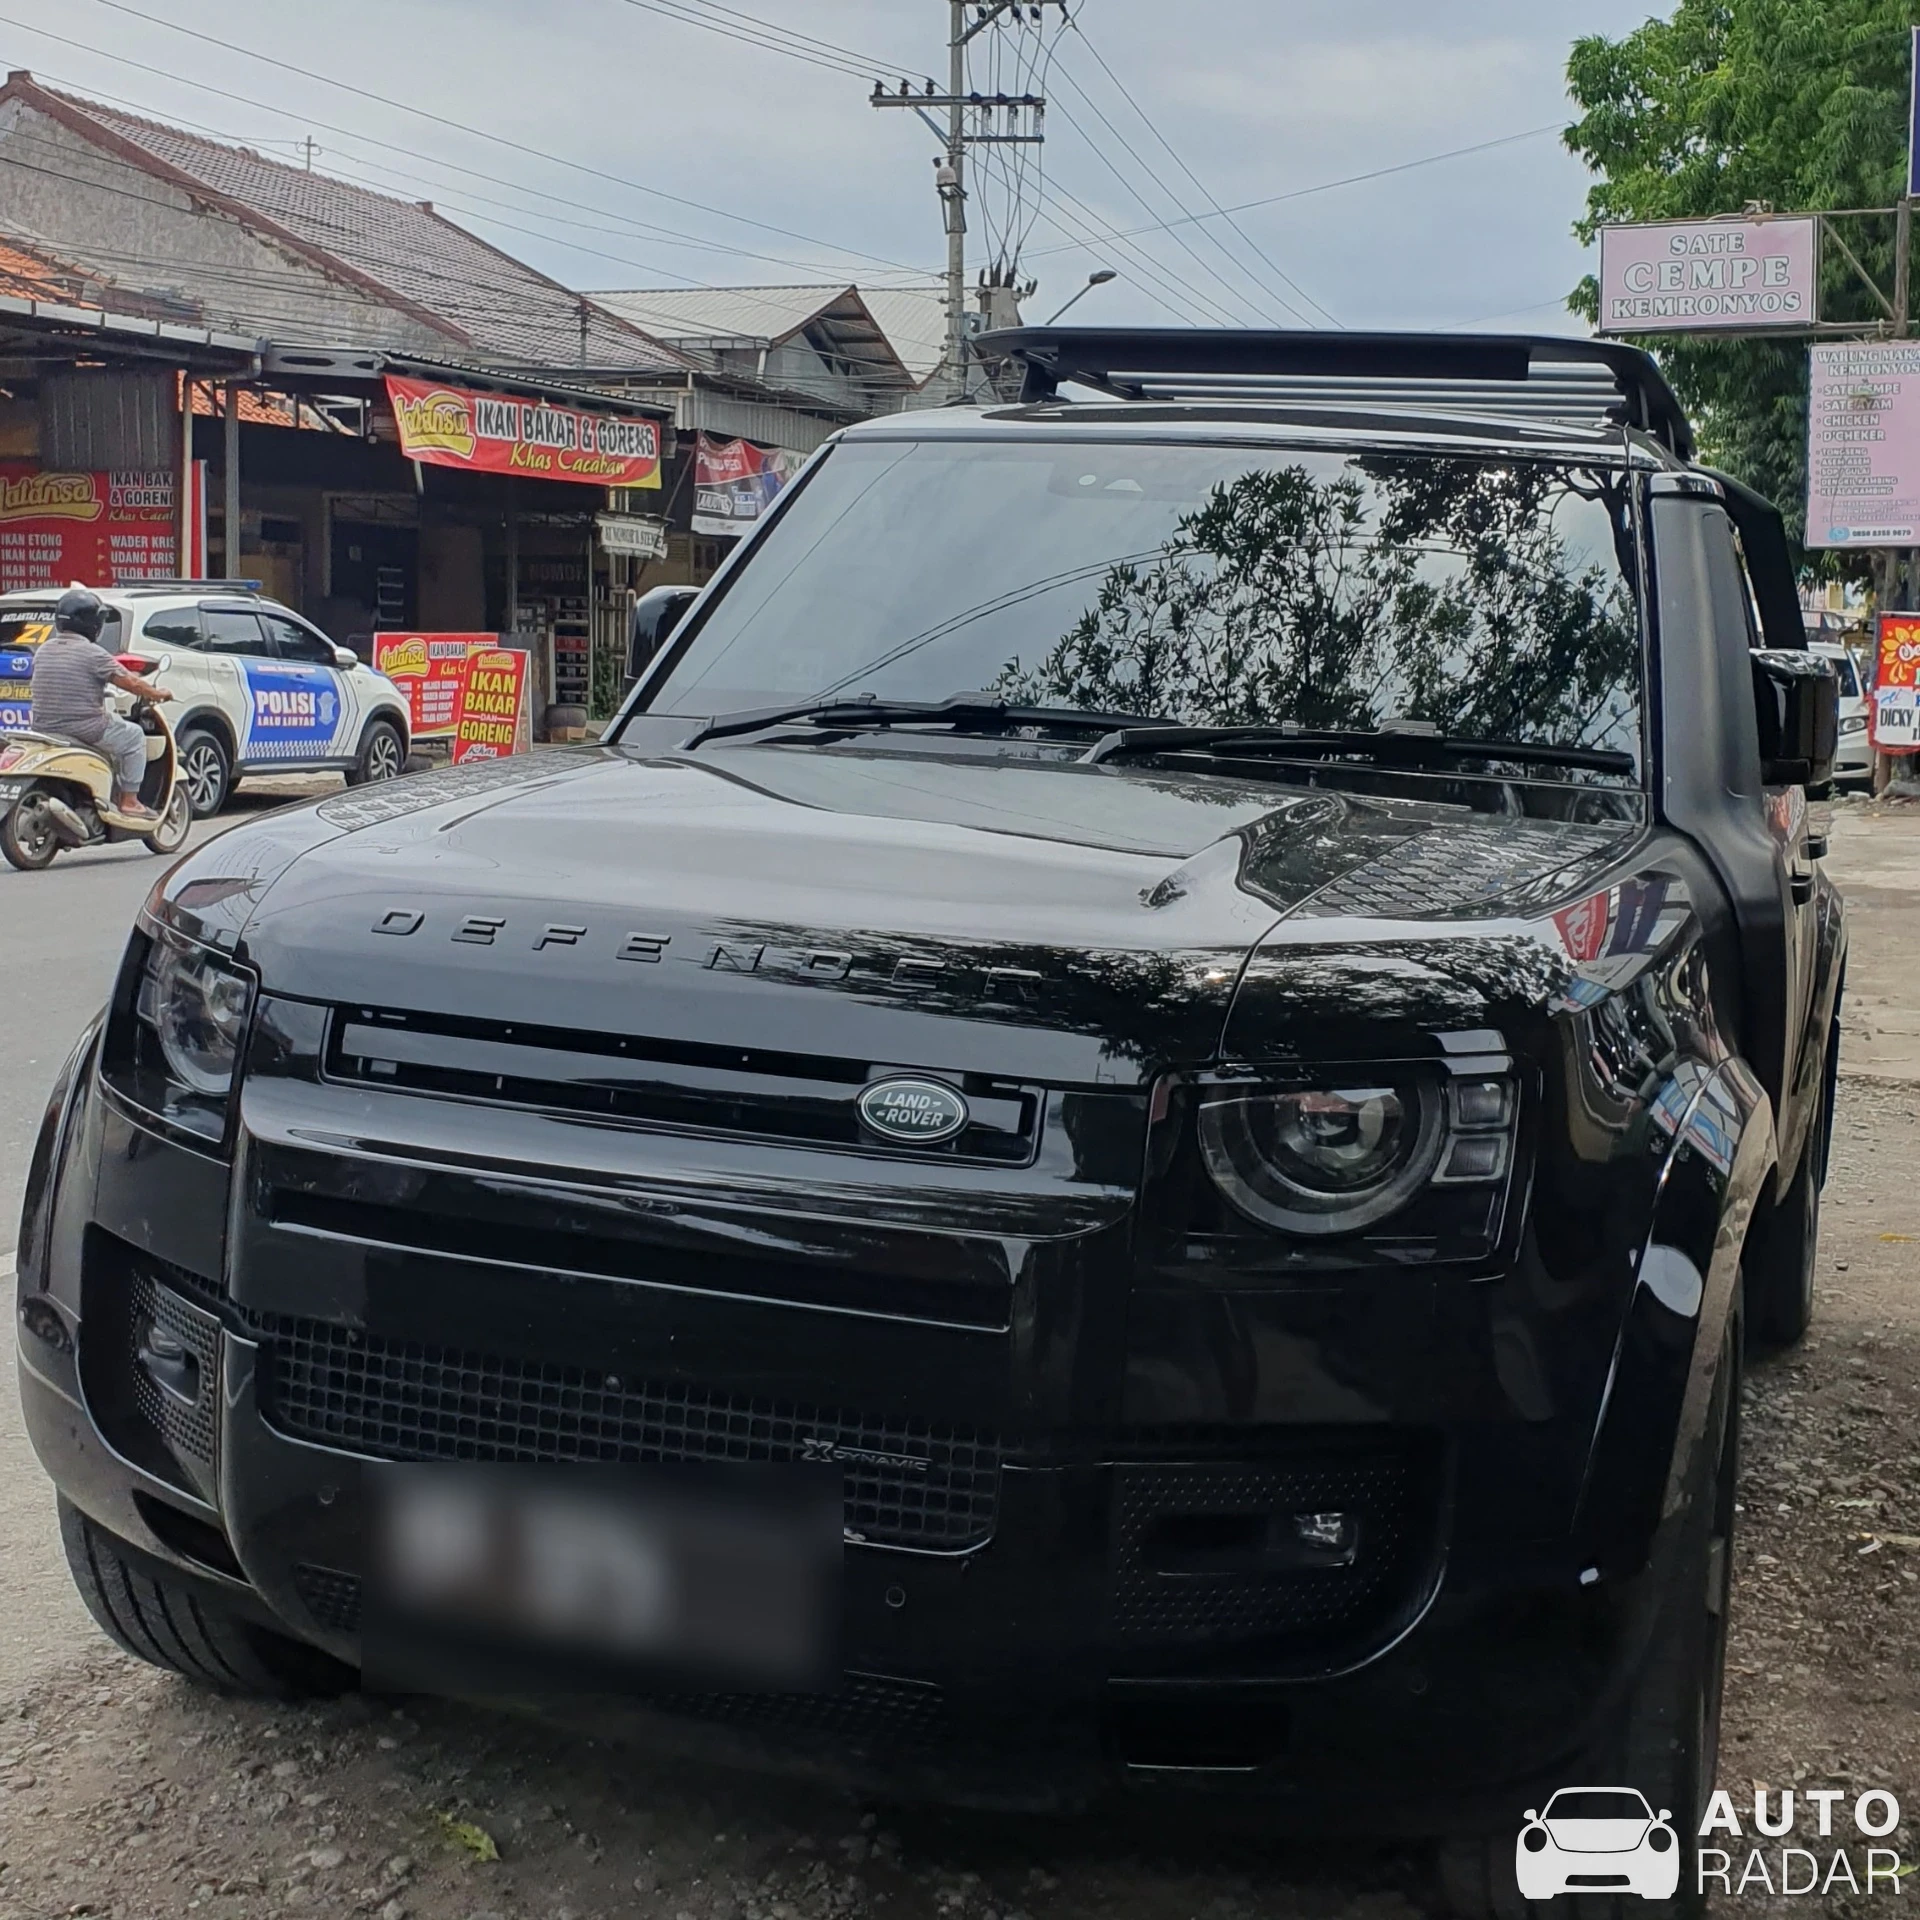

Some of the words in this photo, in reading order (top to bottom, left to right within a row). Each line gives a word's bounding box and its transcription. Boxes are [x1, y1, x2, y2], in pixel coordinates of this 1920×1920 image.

[1670, 232, 1744, 256] SATE
[1624, 256, 1791, 293] CEMPE
[1611, 292, 1801, 320] KEMRONYOS
[1817, 350, 1878, 363] WARUNG
[1823, 384, 1854, 396] SATE
[1823, 400, 1854, 411] SATE
[1856, 399, 1892, 410] AYAM
[1823, 414, 1880, 426] CHICKEN
[477, 400, 518, 438] IKAN
[524, 407, 576, 447] BAKAR
[581, 419, 593, 449] &
[598, 421, 655, 456] GORENG
[1823, 430, 1885, 442] D'CHEKER
[510, 443, 551, 470] Khas
[557, 446, 626, 475] Cacaban
[111, 472, 140, 487] IKAN
[111, 490, 121, 505] &
[1, 534, 25, 546] IKAN
[28, 534, 62, 546] ETONG
[111, 535, 148, 548] WADER
[1, 550, 25, 561] IKAN
[29, 550, 62, 561] KAKAP
[111, 552, 146, 564] UDANG
[2, 565, 26, 577] IKAN
[111, 567, 143, 579] TELOR
[431, 643, 445, 658] IKAN
[471, 671, 517, 693] IKAN
[256, 690, 315, 714] POLISI
[465, 692, 515, 715] BAKAR
[258, 716, 281, 726] LALU
[283, 716, 315, 726] LINTAS
[480, 714, 497, 722] DAN
[1880, 708, 1914, 727] DICKY
[460, 720, 513, 744] GORENG
[468, 744, 497, 757] Khas
[371, 906, 1042, 998] DEFENDER
[883, 1092, 930, 1109] LAND
[885, 1108, 943, 1126] ROVER
